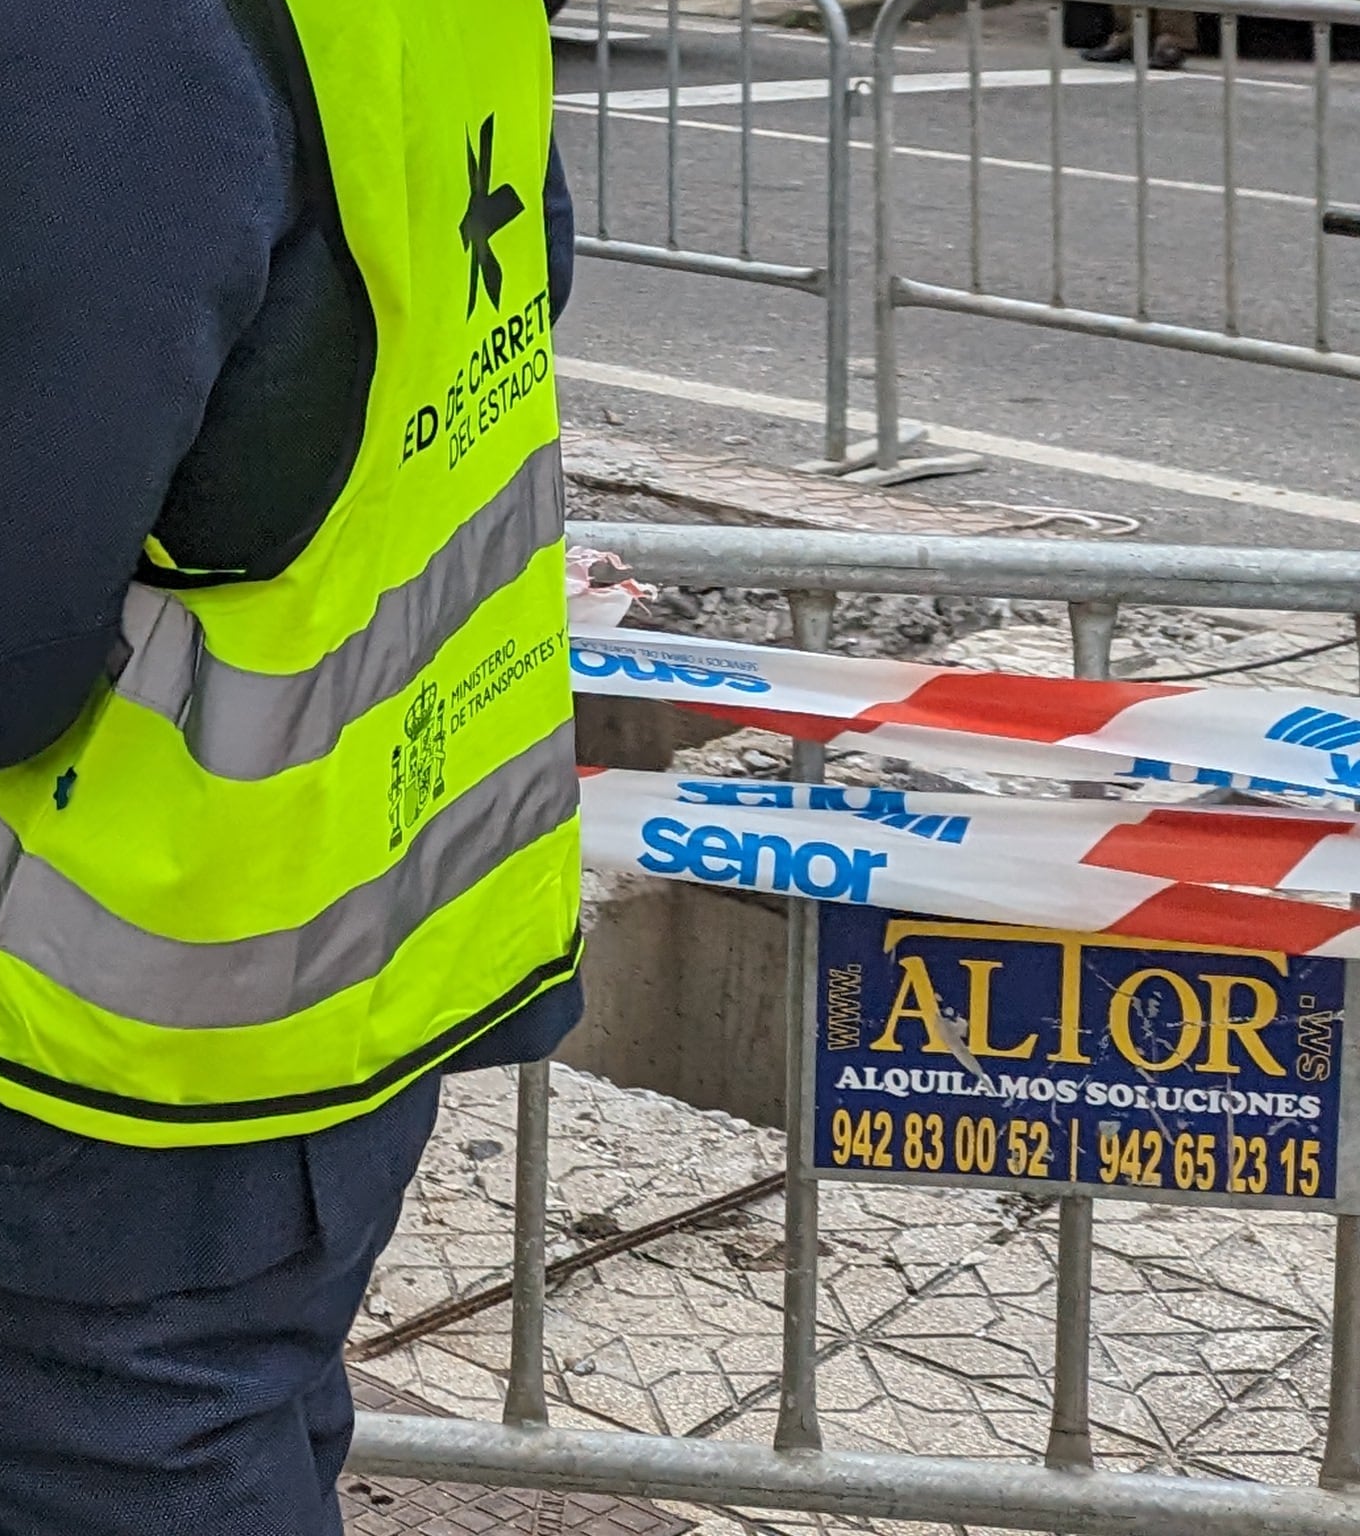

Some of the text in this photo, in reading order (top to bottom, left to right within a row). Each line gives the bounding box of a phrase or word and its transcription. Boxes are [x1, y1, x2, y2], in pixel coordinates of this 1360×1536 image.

[400, 289, 549, 466] ED DE CARRET
[449, 348, 548, 470] DEL ESTADO
[450, 628, 566, 734] DE TRANSPORTES Y
[451, 639, 516, 709] MINISTERIO
[570, 647, 772, 694] seno
[637, 816, 888, 904] senor
[870, 920, 1289, 1077] ALTOR
[834, 1066, 1321, 1119] ALQUILAMOS SOLUCIONES
[832, 1108, 1321, 1197] 942 83 00 52 942 65 23 15
